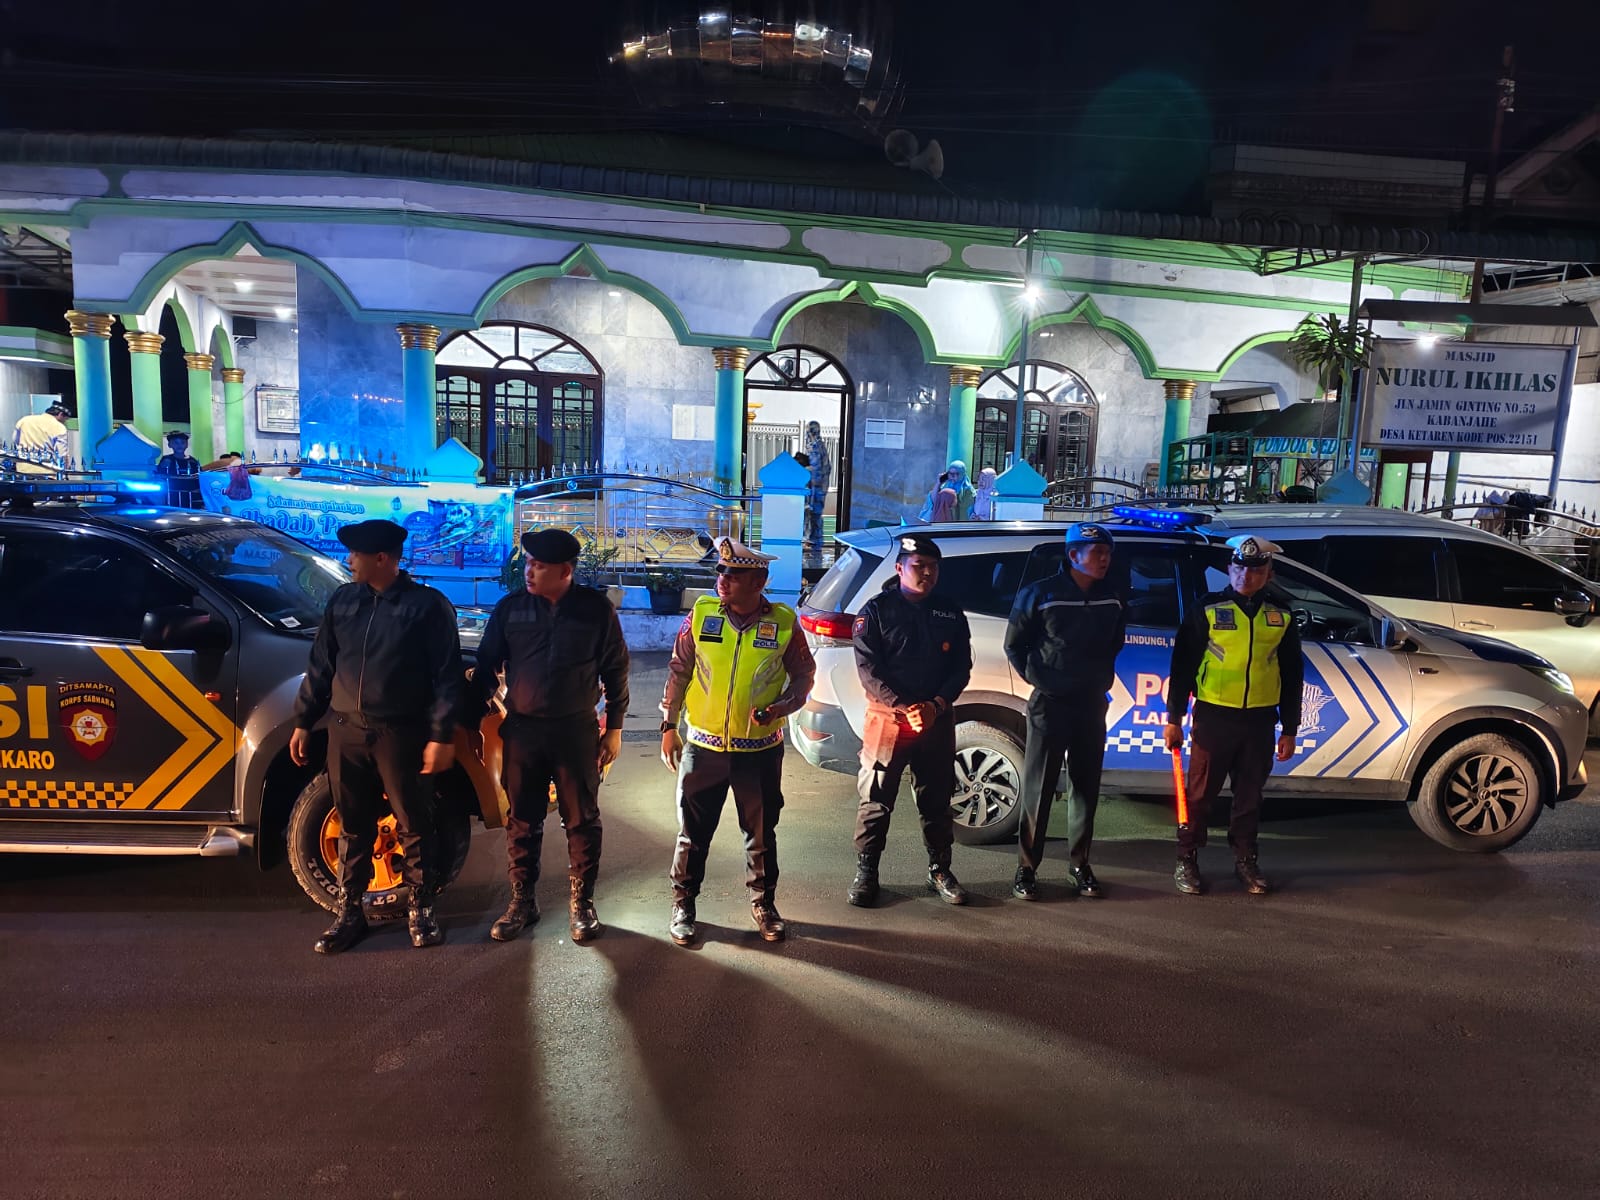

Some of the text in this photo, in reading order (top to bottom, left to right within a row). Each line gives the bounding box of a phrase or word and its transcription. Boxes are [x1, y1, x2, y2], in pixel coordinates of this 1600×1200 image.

[1445, 351, 1496, 363] MASJID
[1376, 367, 1557, 393] NURUL IKHLAS
[1394, 398, 1536, 415] JLN JAMIN GINTING NO.53
[1427, 415, 1497, 428] KABANJAHE
[1379, 428, 1538, 446] DESA KETAREN KODE POS.22151
[1255, 437, 1308, 454] PONDOK
[267, 496, 305, 510] Selamat
[60, 682, 115, 695] DITSAMAPTA
[60, 695, 82, 708] KORPS
